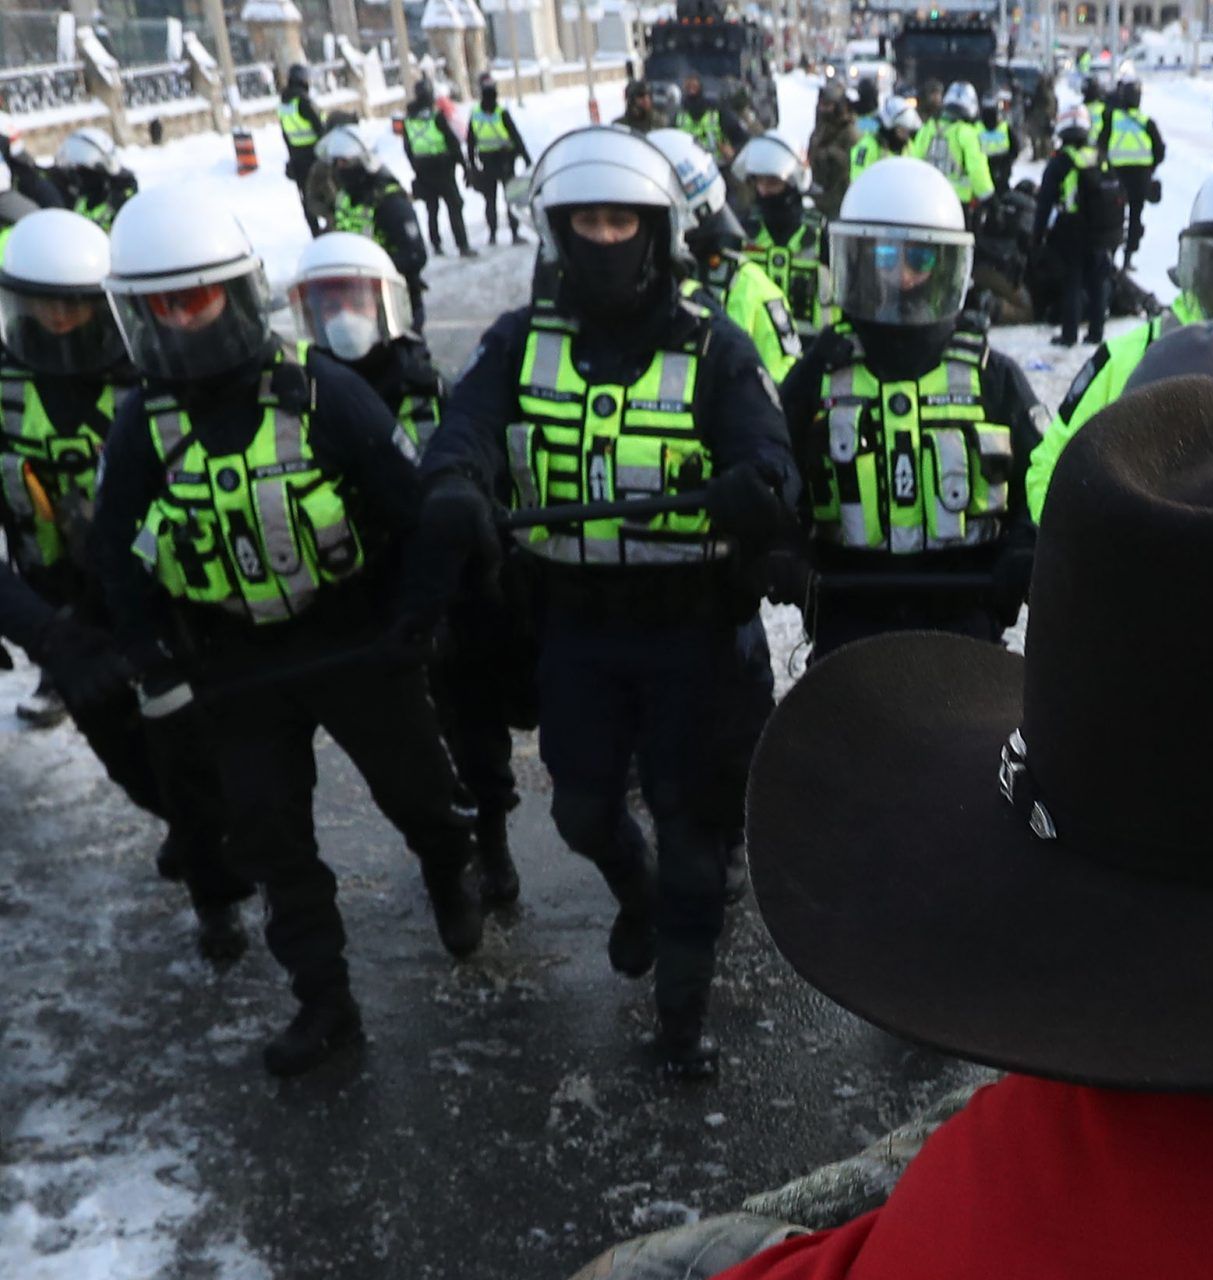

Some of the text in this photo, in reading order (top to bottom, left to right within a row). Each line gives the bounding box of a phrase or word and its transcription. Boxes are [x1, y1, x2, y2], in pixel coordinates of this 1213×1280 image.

[631, 399, 683, 412] POLICE
[927, 395, 974, 405] POLICE
[895, 453, 913, 476] A
[896, 476, 914, 498] 12
[235, 535, 255, 560] A
